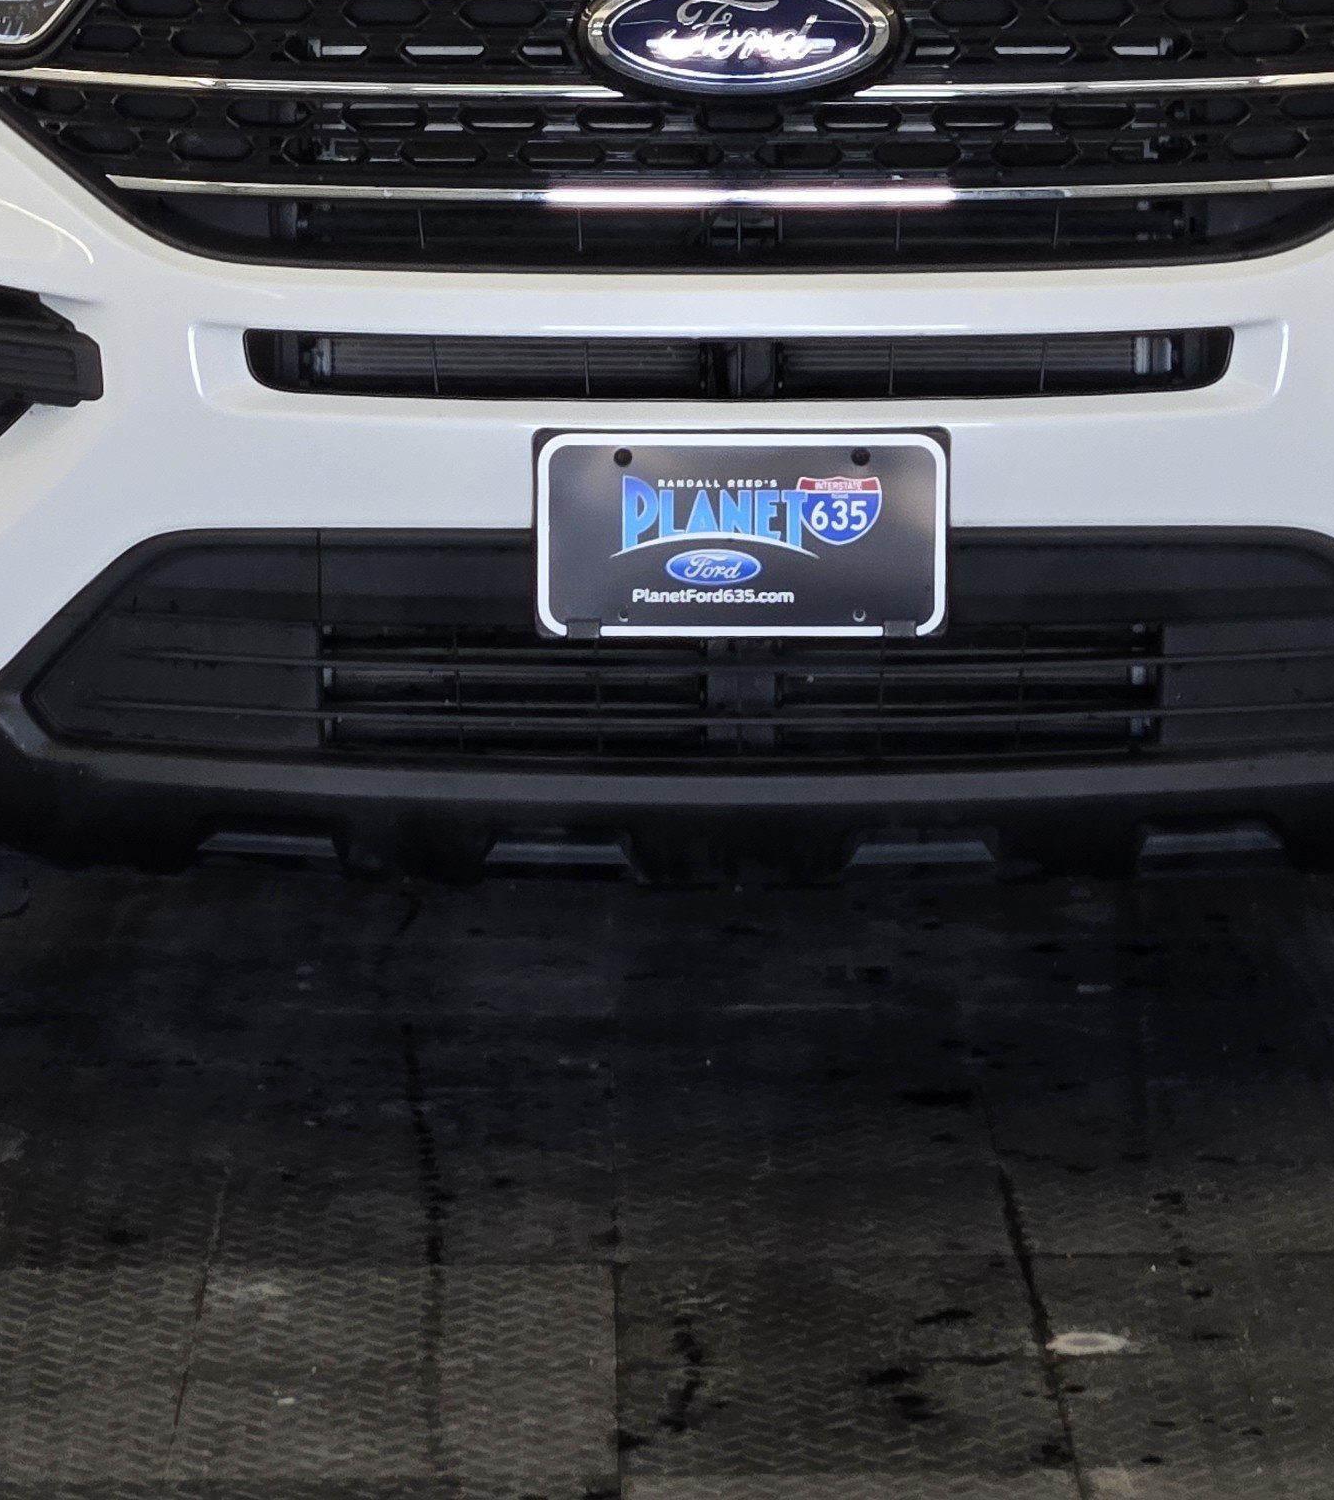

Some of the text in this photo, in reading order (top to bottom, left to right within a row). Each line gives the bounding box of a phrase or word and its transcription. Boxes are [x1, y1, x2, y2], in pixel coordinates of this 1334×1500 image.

[657, 478, 778, 488] RANDALL REED'S
[814, 480, 862, 491] INTERSTATE
[622, 475, 808, 551] PLANET
[811, 500, 868, 531] 635
[683, 553, 742, 579] Ford
[631, 588, 796, 604] PlanetFord635.com
